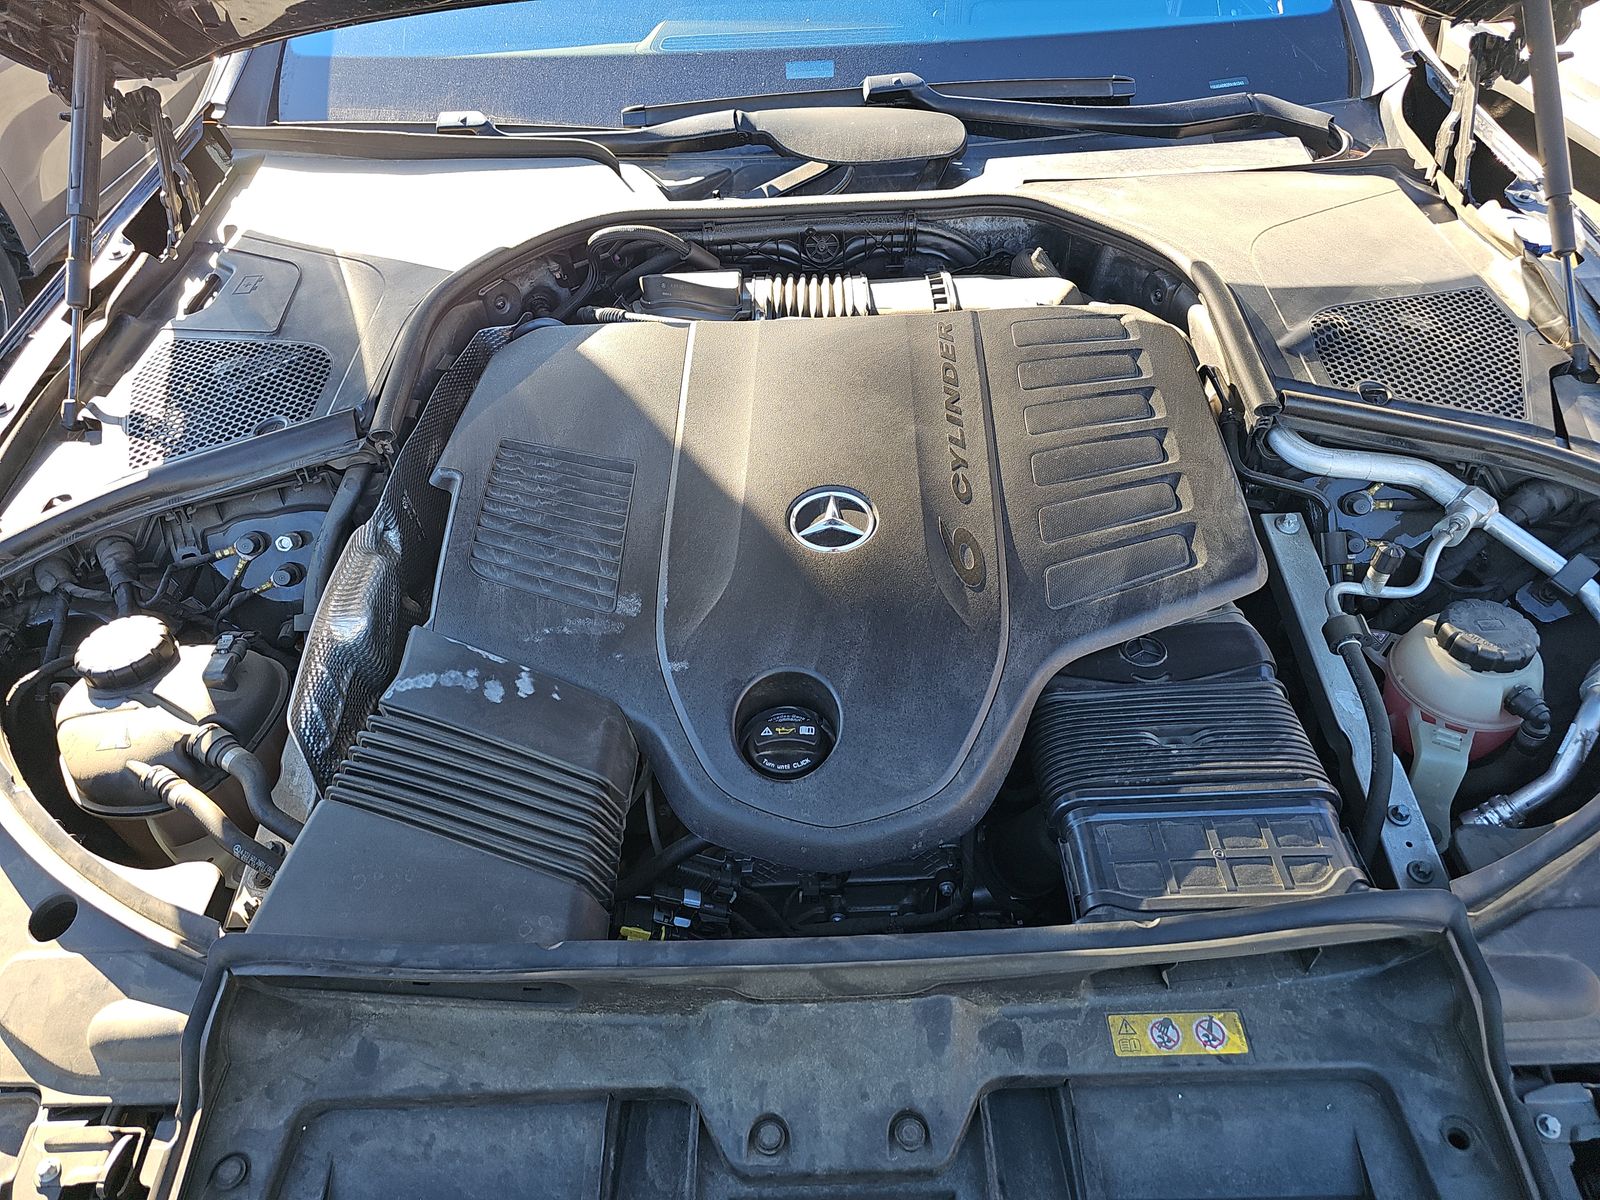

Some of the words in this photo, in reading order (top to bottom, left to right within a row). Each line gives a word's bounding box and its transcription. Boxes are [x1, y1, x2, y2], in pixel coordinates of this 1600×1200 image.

[937, 321, 972, 505] CYLINDER
[938, 516, 986, 591] 6
[763, 758, 775, 768] Turn
[792, 757, 811, 769] CLICK
